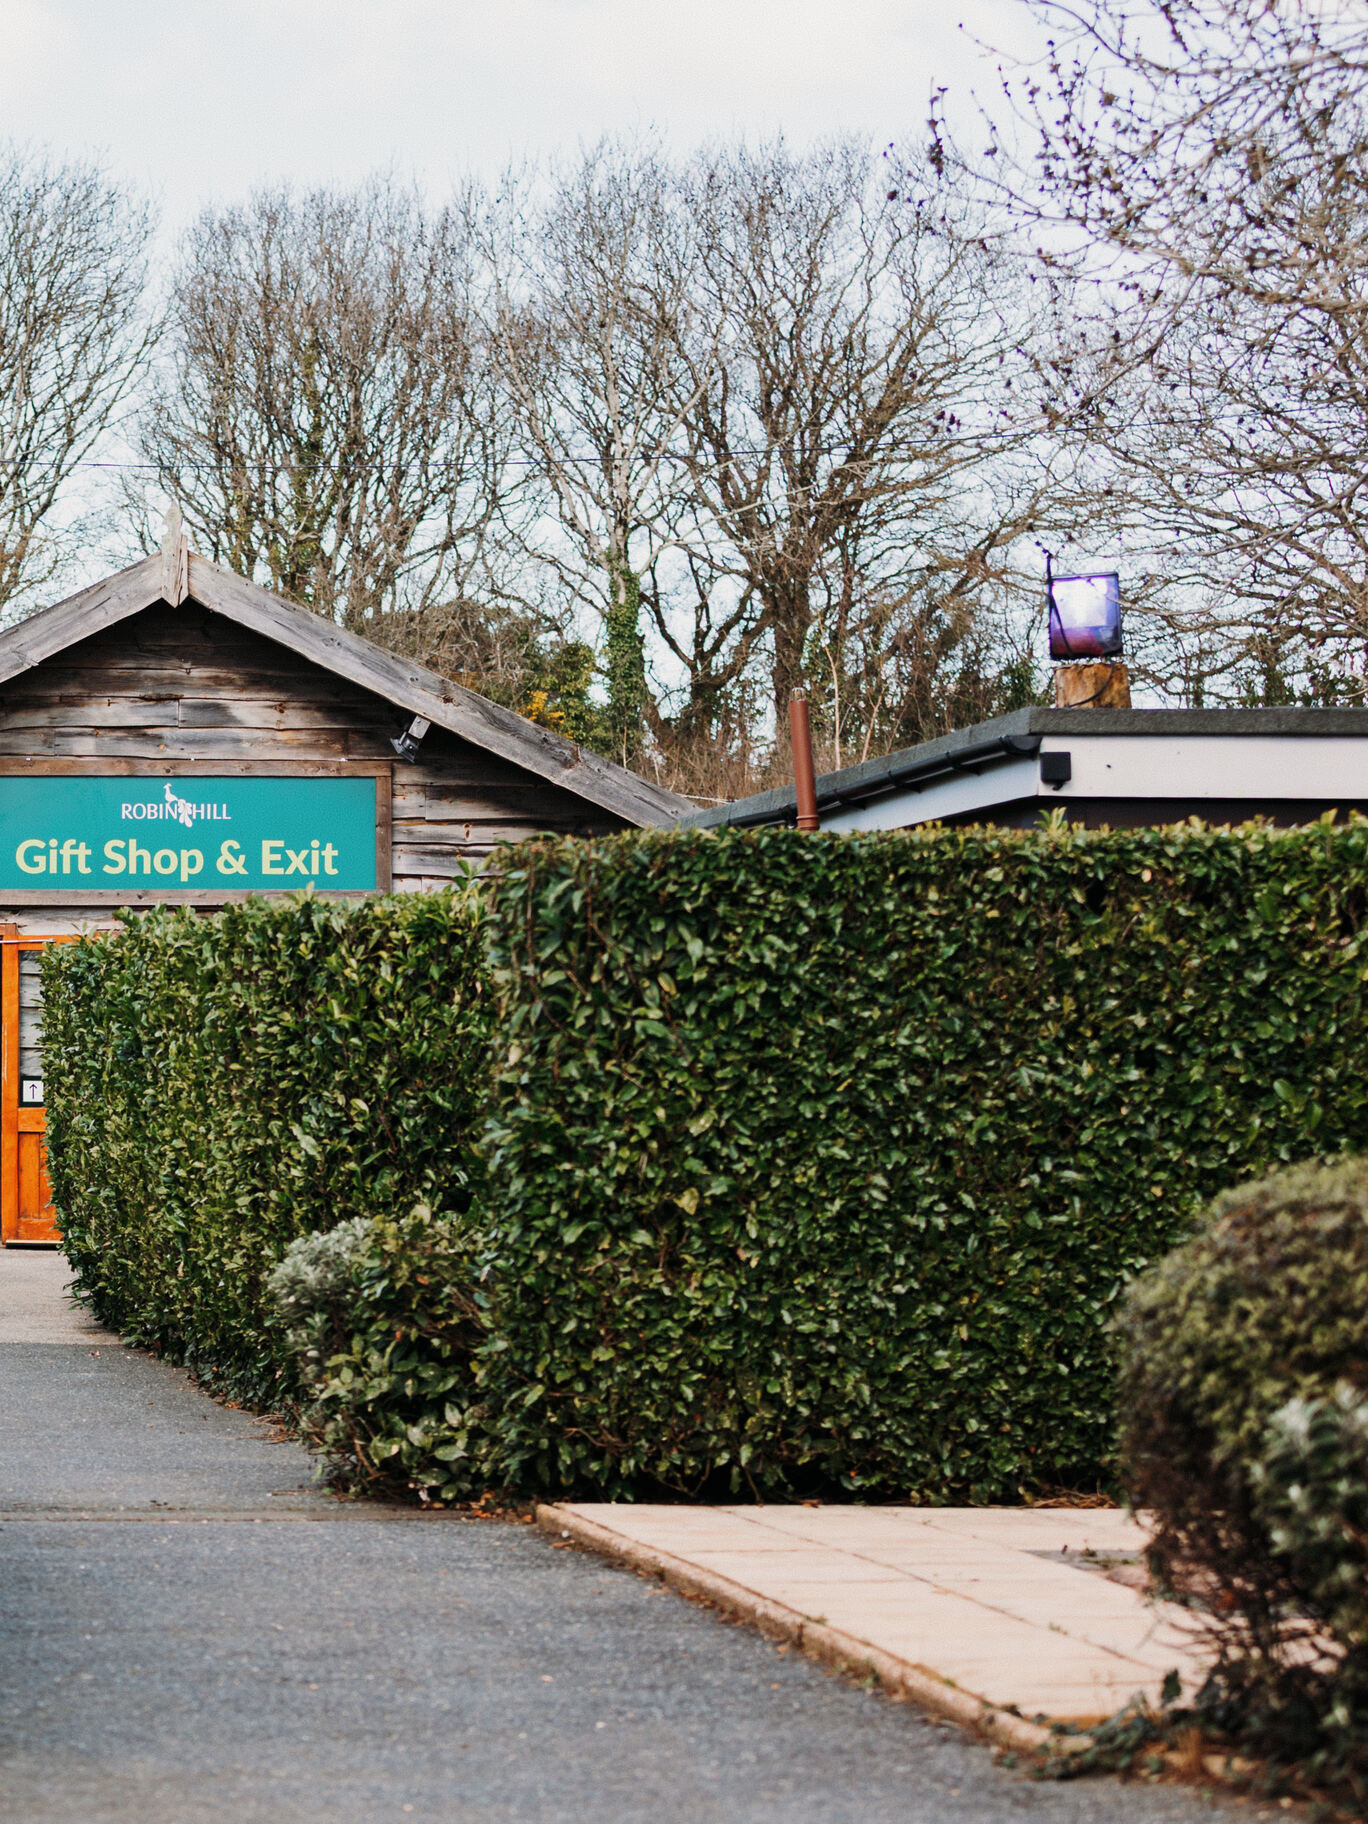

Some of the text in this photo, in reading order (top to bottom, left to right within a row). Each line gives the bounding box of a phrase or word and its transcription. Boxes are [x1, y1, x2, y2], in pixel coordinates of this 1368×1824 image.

[121, 803, 232, 820] ROBIN HILL
[15, 838, 339, 882] Gift Shop & Exit
